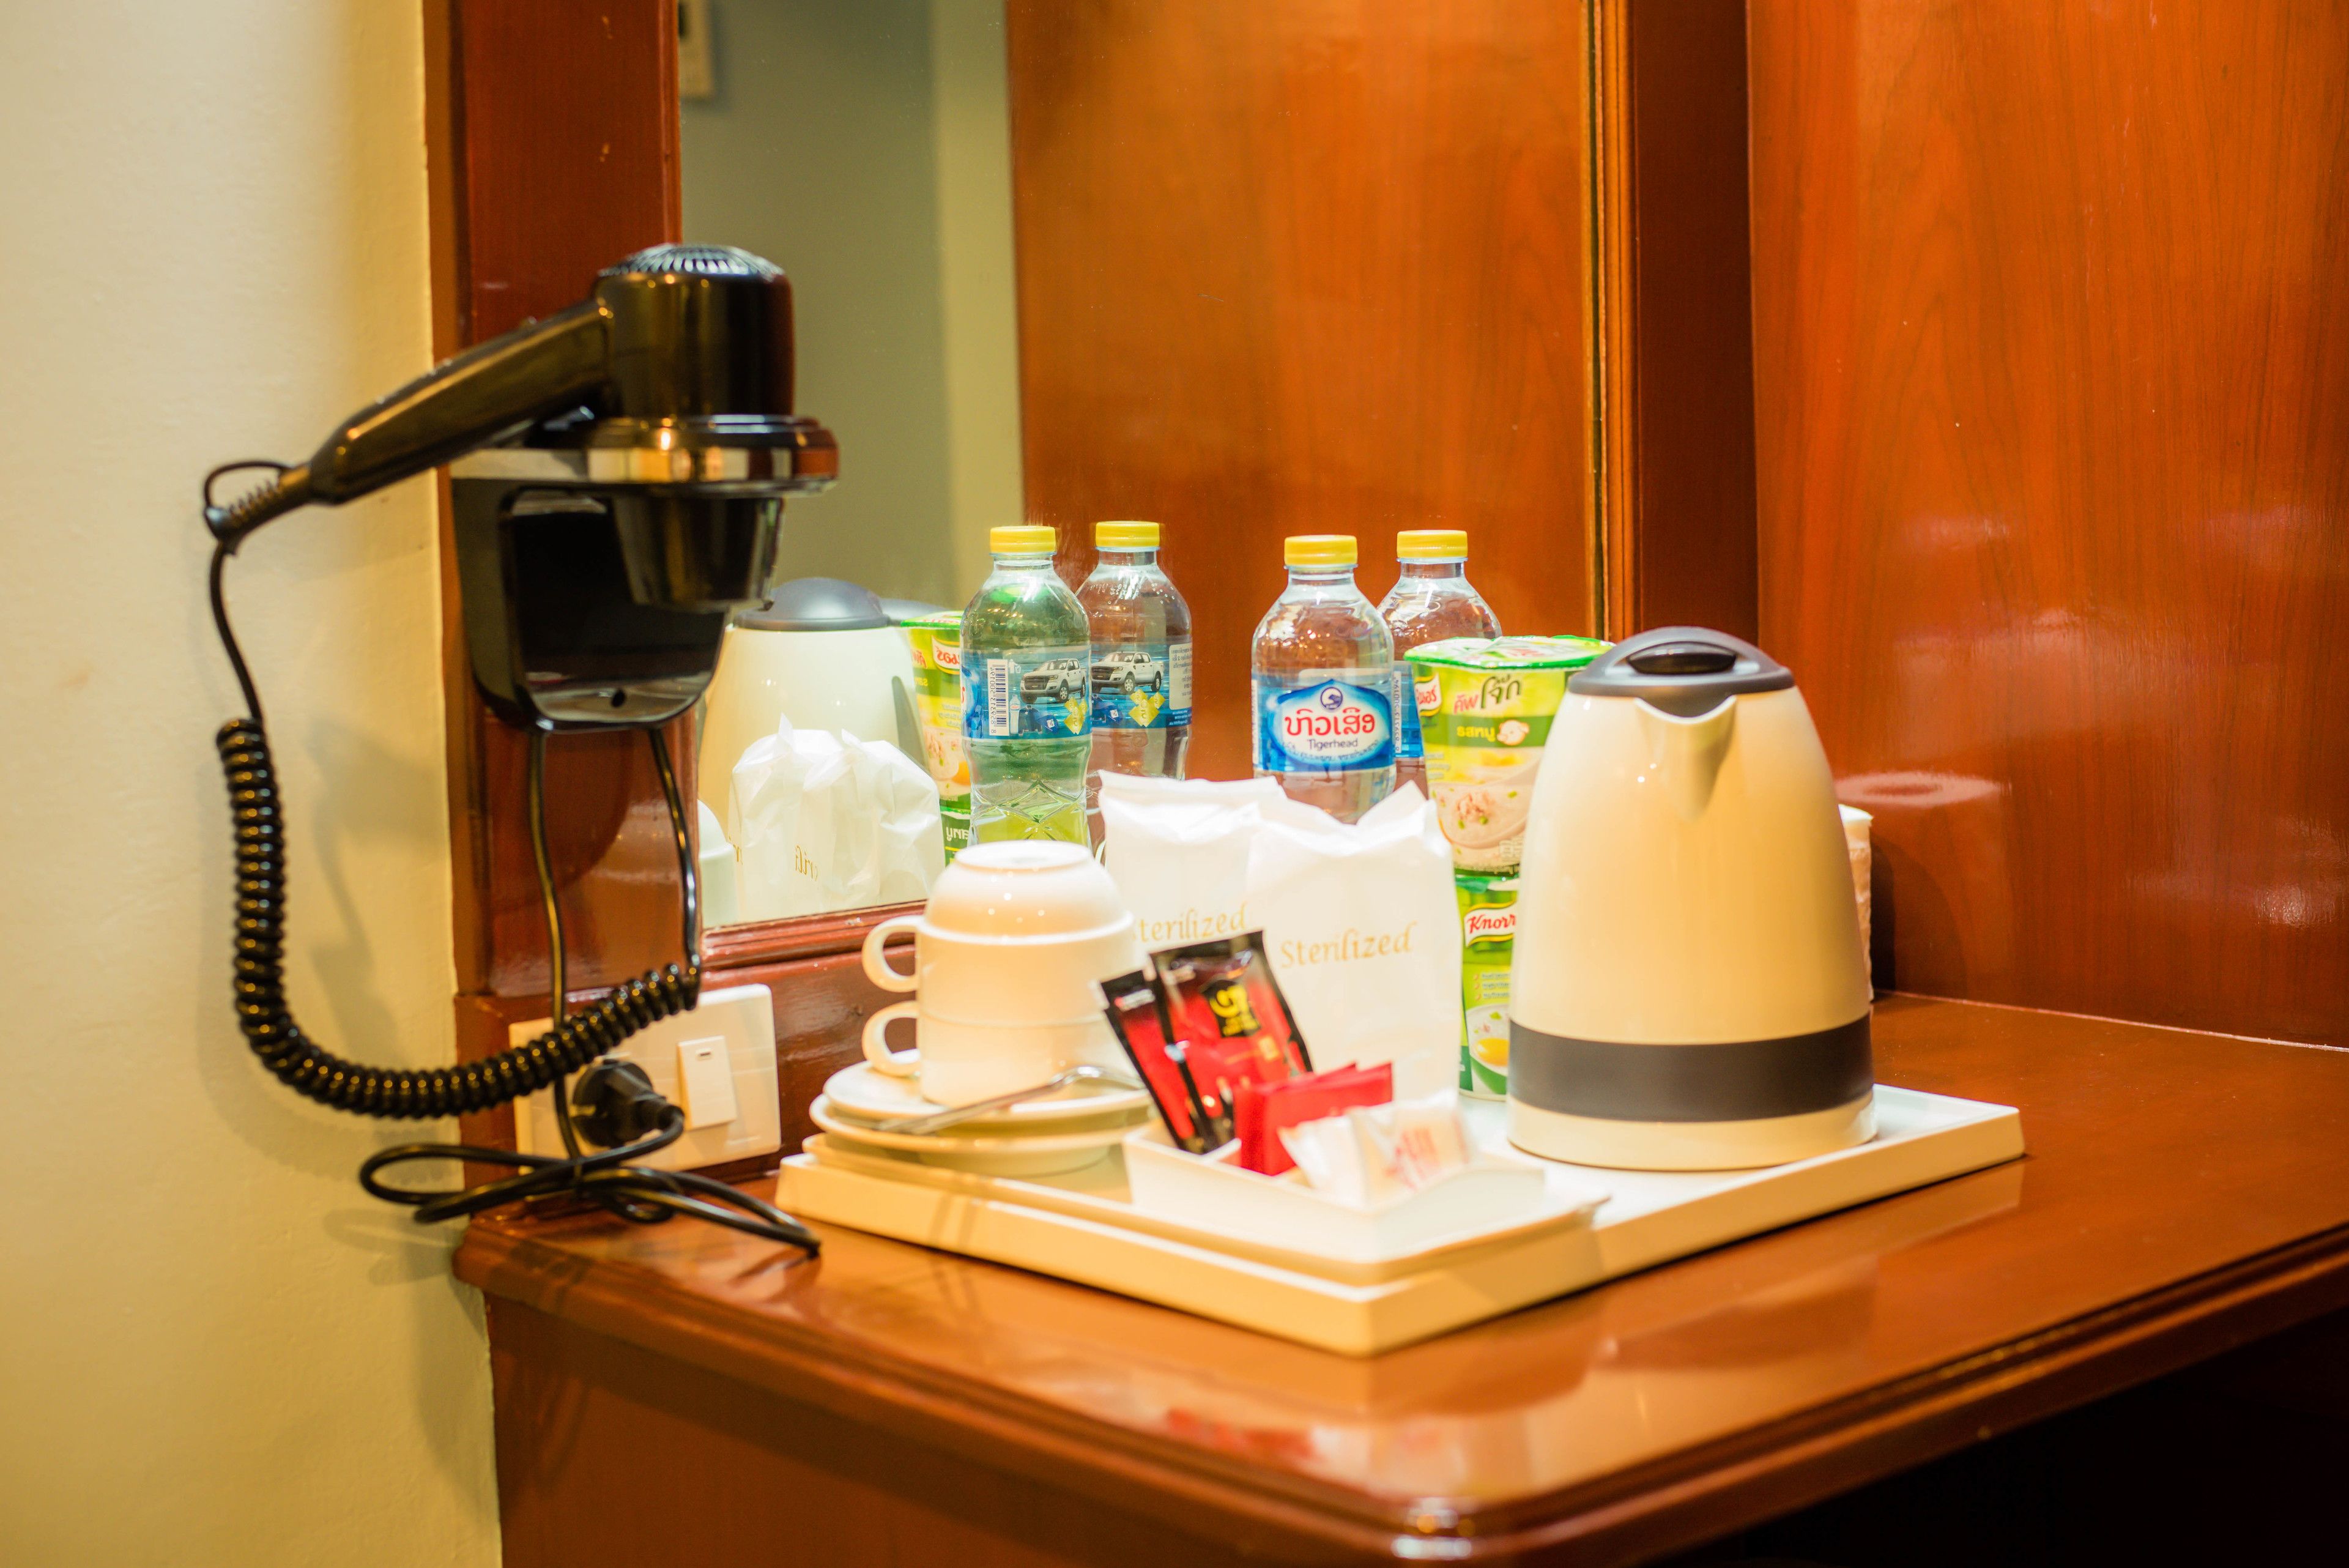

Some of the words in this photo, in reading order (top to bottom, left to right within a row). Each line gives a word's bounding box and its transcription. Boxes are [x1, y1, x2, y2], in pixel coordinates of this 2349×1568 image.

[1307, 738, 1358, 751] Tigerhead
[1132, 901, 1247, 942] terilized
[1467, 913, 1516, 934] Knorr
[1280, 920, 1417, 969] Sterilized
